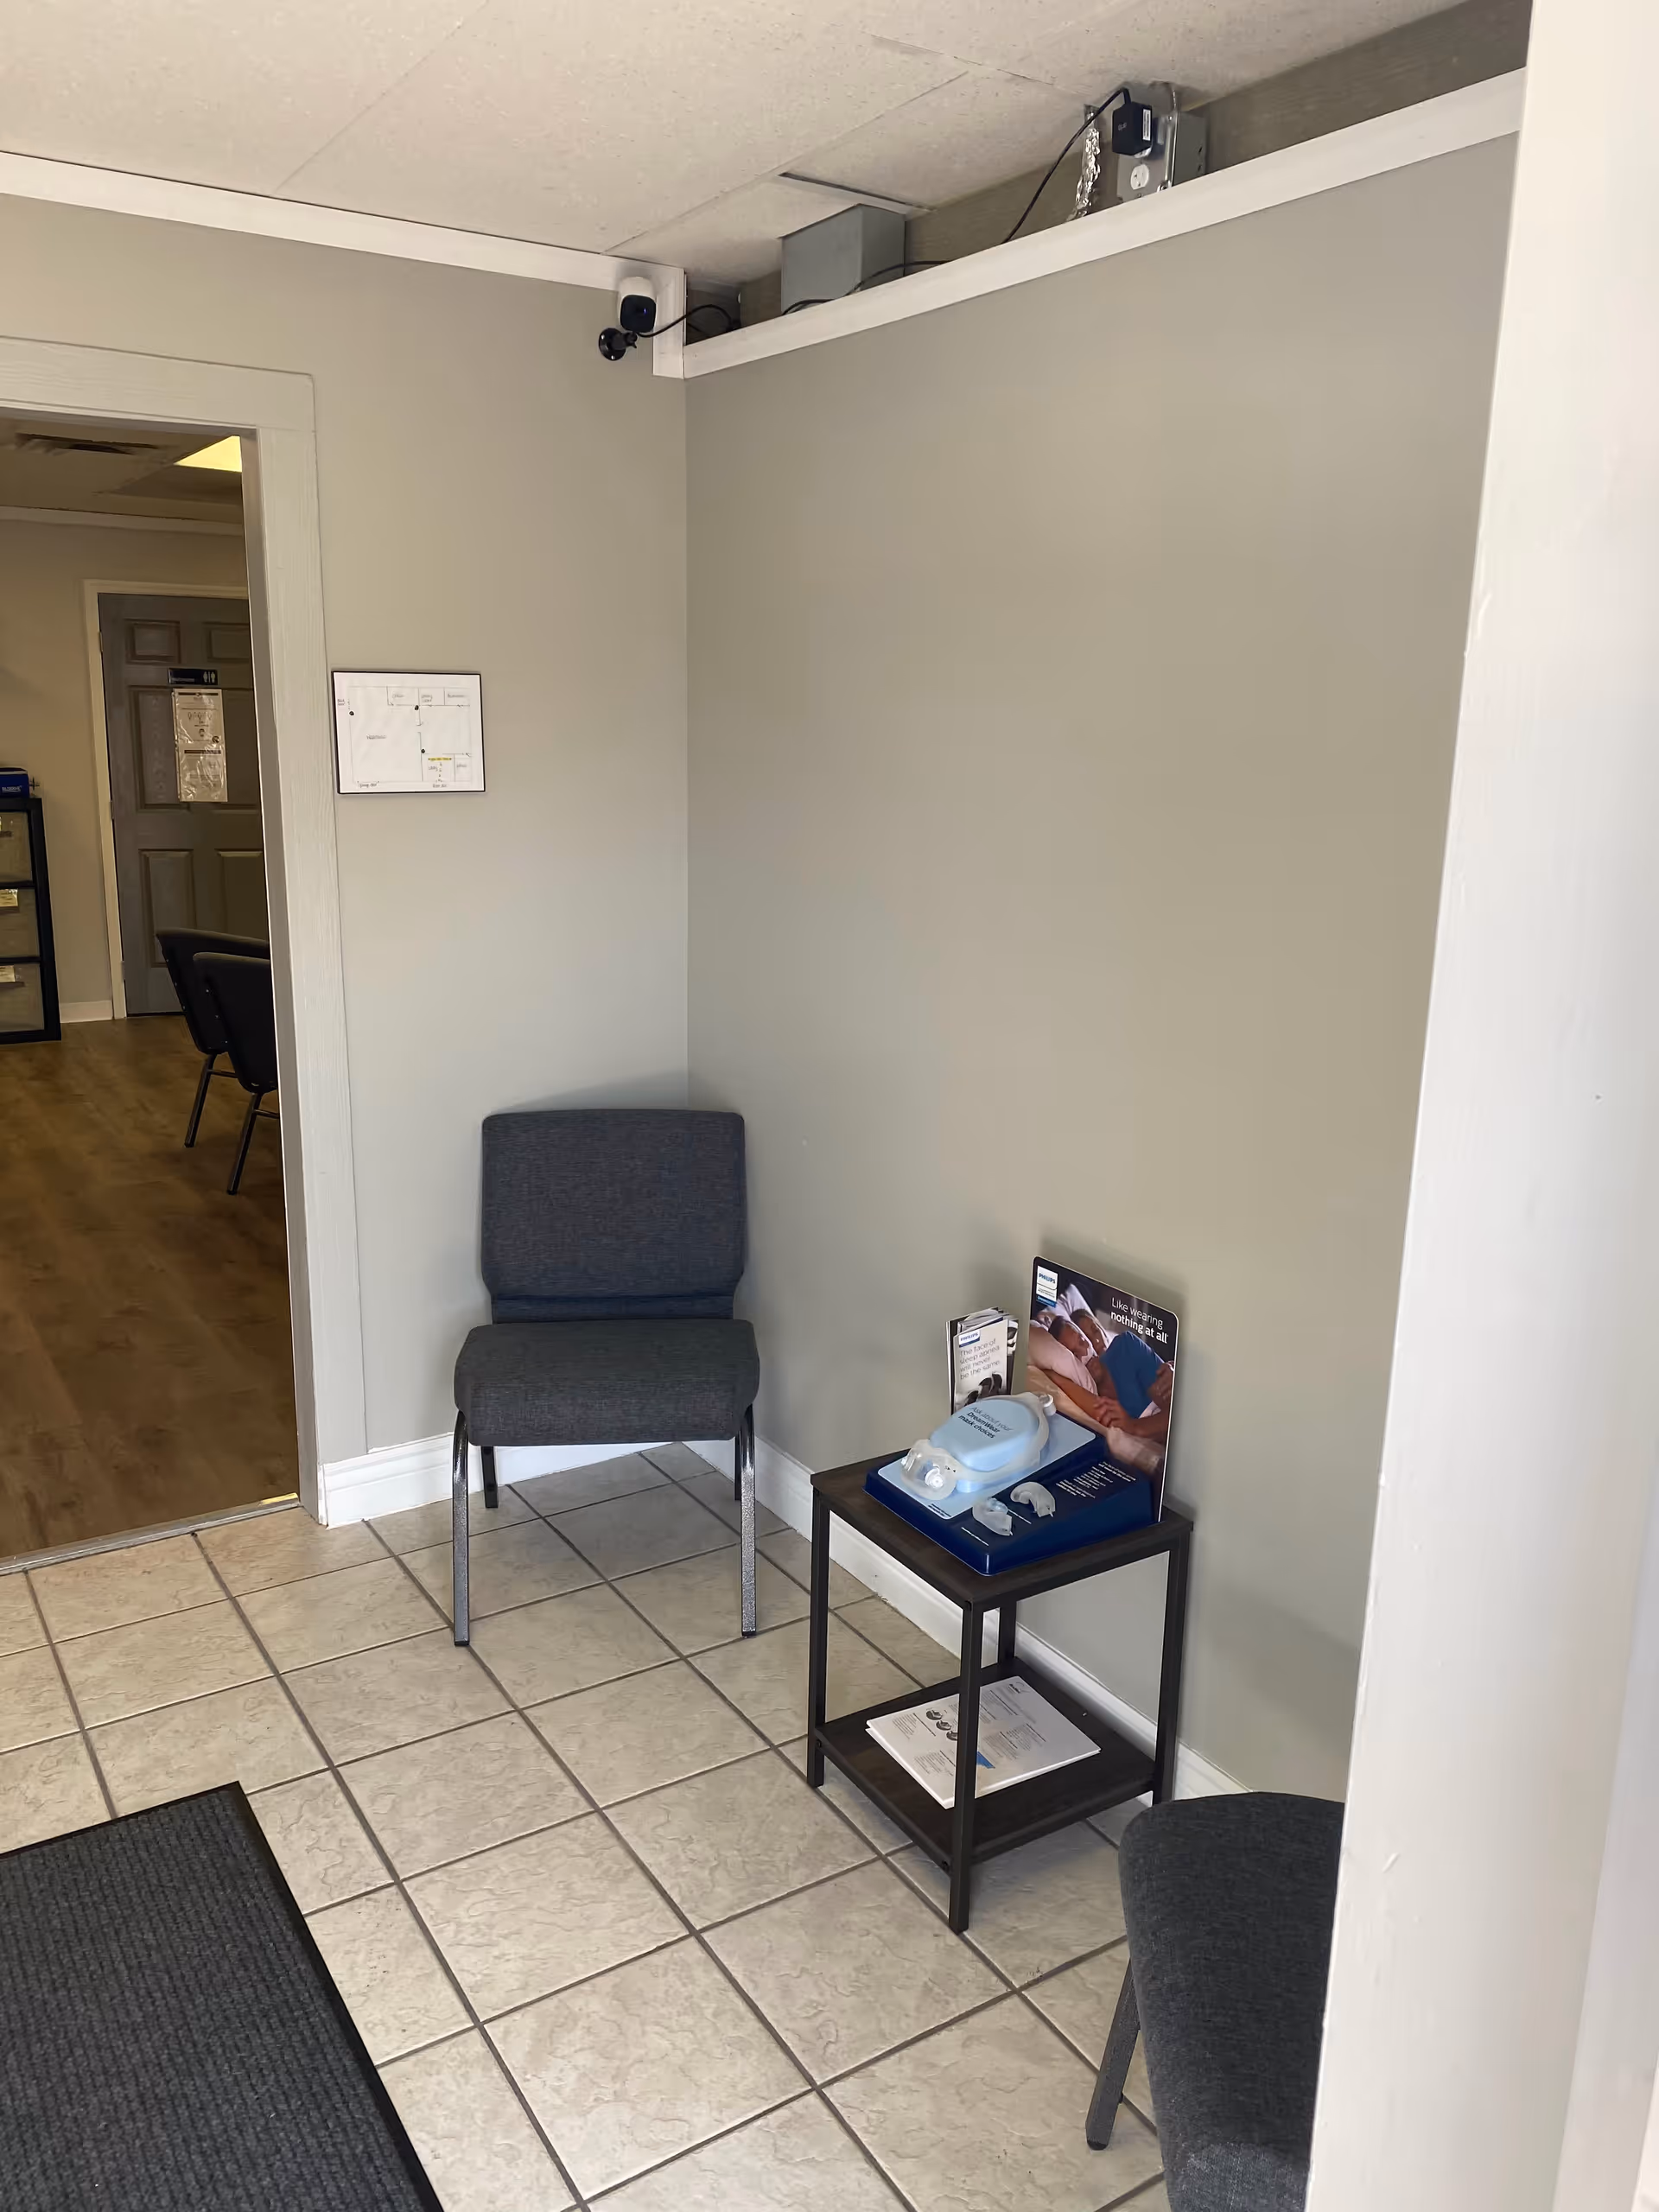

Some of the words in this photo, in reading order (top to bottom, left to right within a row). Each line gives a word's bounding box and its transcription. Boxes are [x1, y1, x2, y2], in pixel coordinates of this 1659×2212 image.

[1039, 1273, 1056, 1284] PHILIPS
[1111, 1297, 1128, 1313] Like
[1129, 1307, 1163, 1331] wearing
[1110, 1311, 1144, 1335] nothing
[1145, 1327, 1155, 1338] at
[959, 1354, 978, 1365] sleep
[979, 1345, 1000, 1358] apnea
[974, 1343, 988, 1353] face
[988, 1338, 996, 1346] of
[960, 1363, 971, 1372] will
[972, 1357, 990, 1368] never
[958, 1414, 975, 1427] mask
[973, 1423, 996, 1439] choices
[967, 1411, 1001, 1433] DreamWear
[981, 1412, 1000, 1425] about
